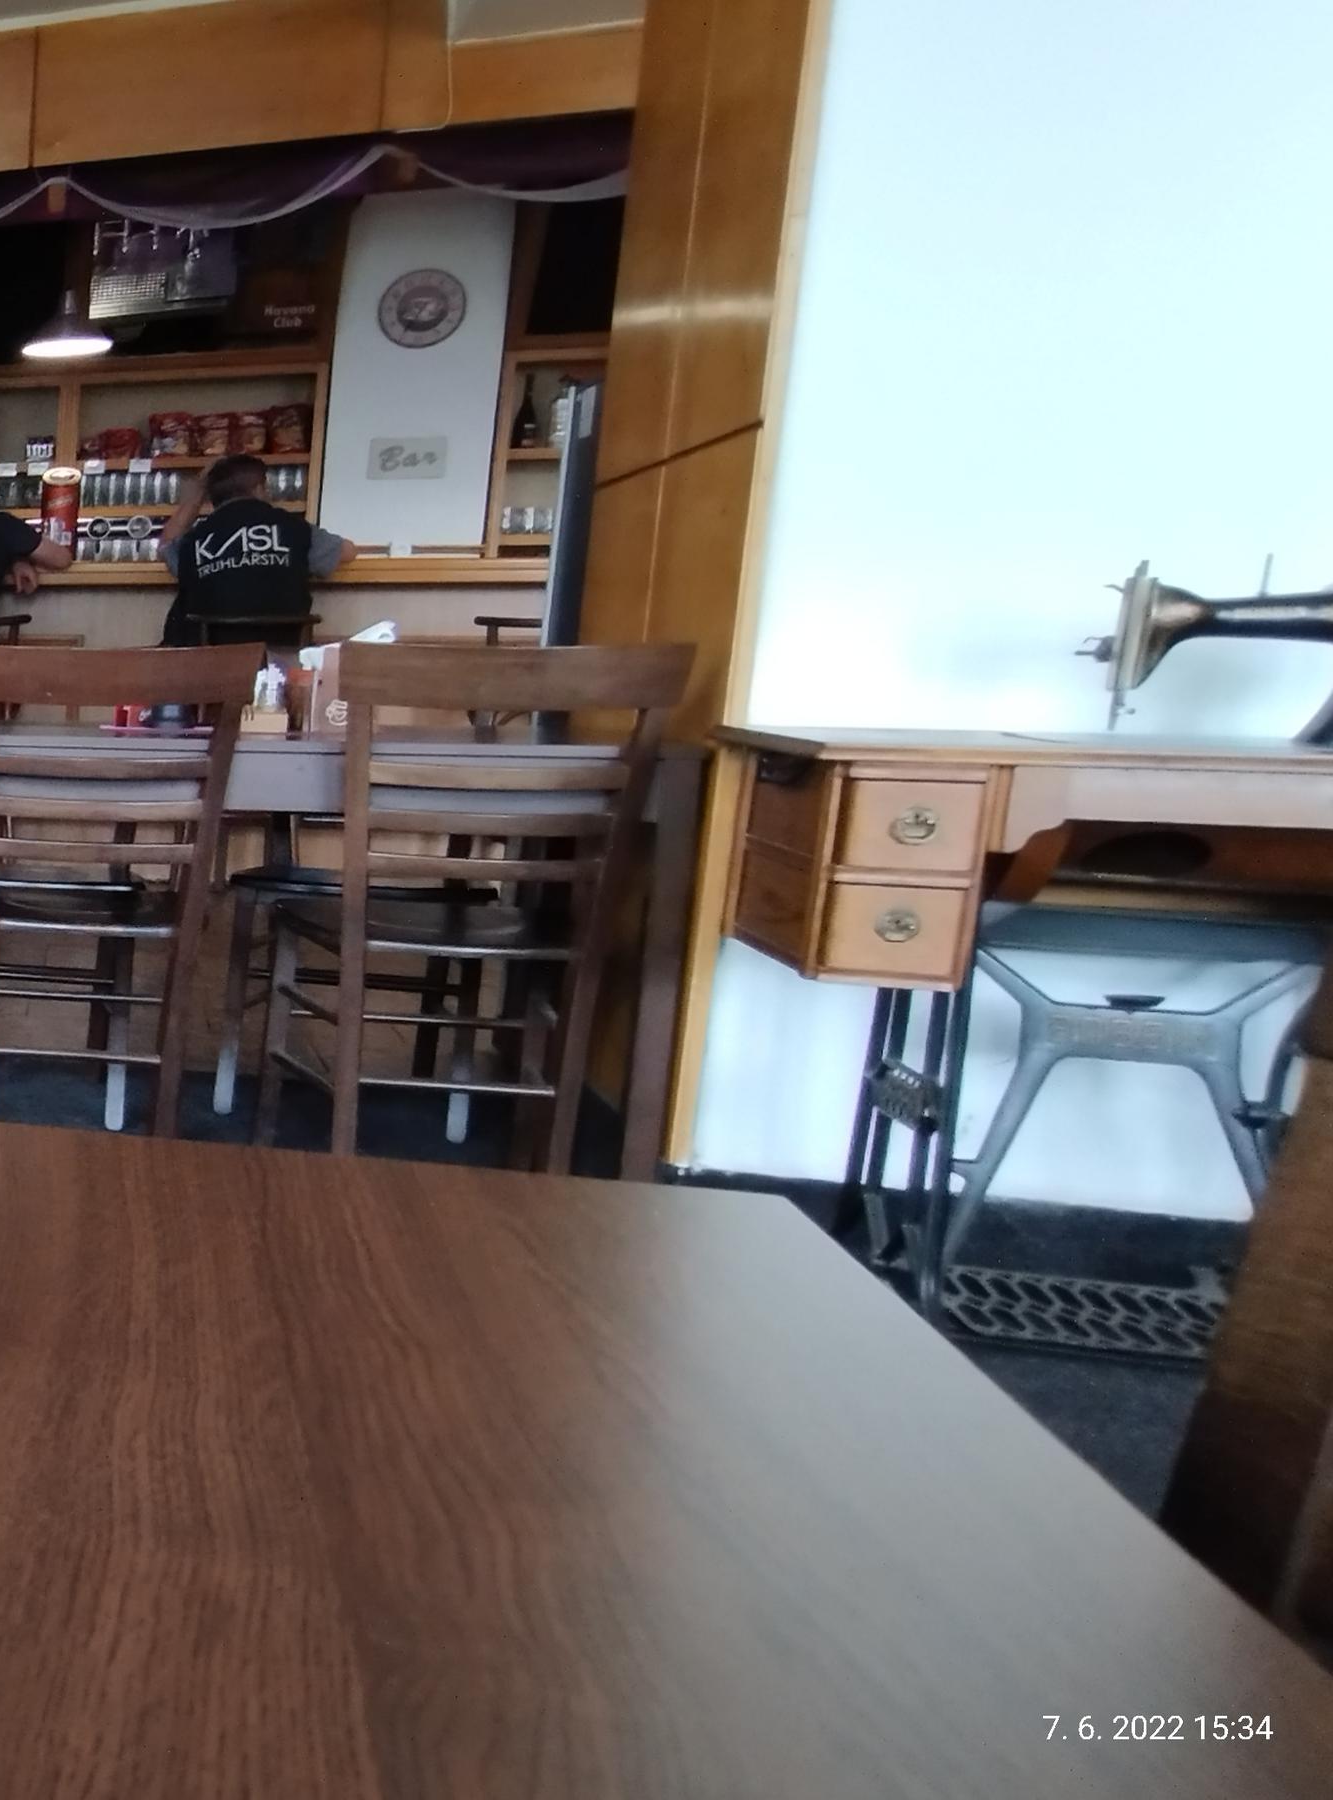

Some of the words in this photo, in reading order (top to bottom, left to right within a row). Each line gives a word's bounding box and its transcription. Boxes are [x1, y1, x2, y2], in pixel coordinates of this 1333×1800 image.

[263, 303, 316, 318] Havana
[273, 316, 303, 329] Club
[378, 445, 438, 472] Bar
[194, 524, 290, 566] KASL
